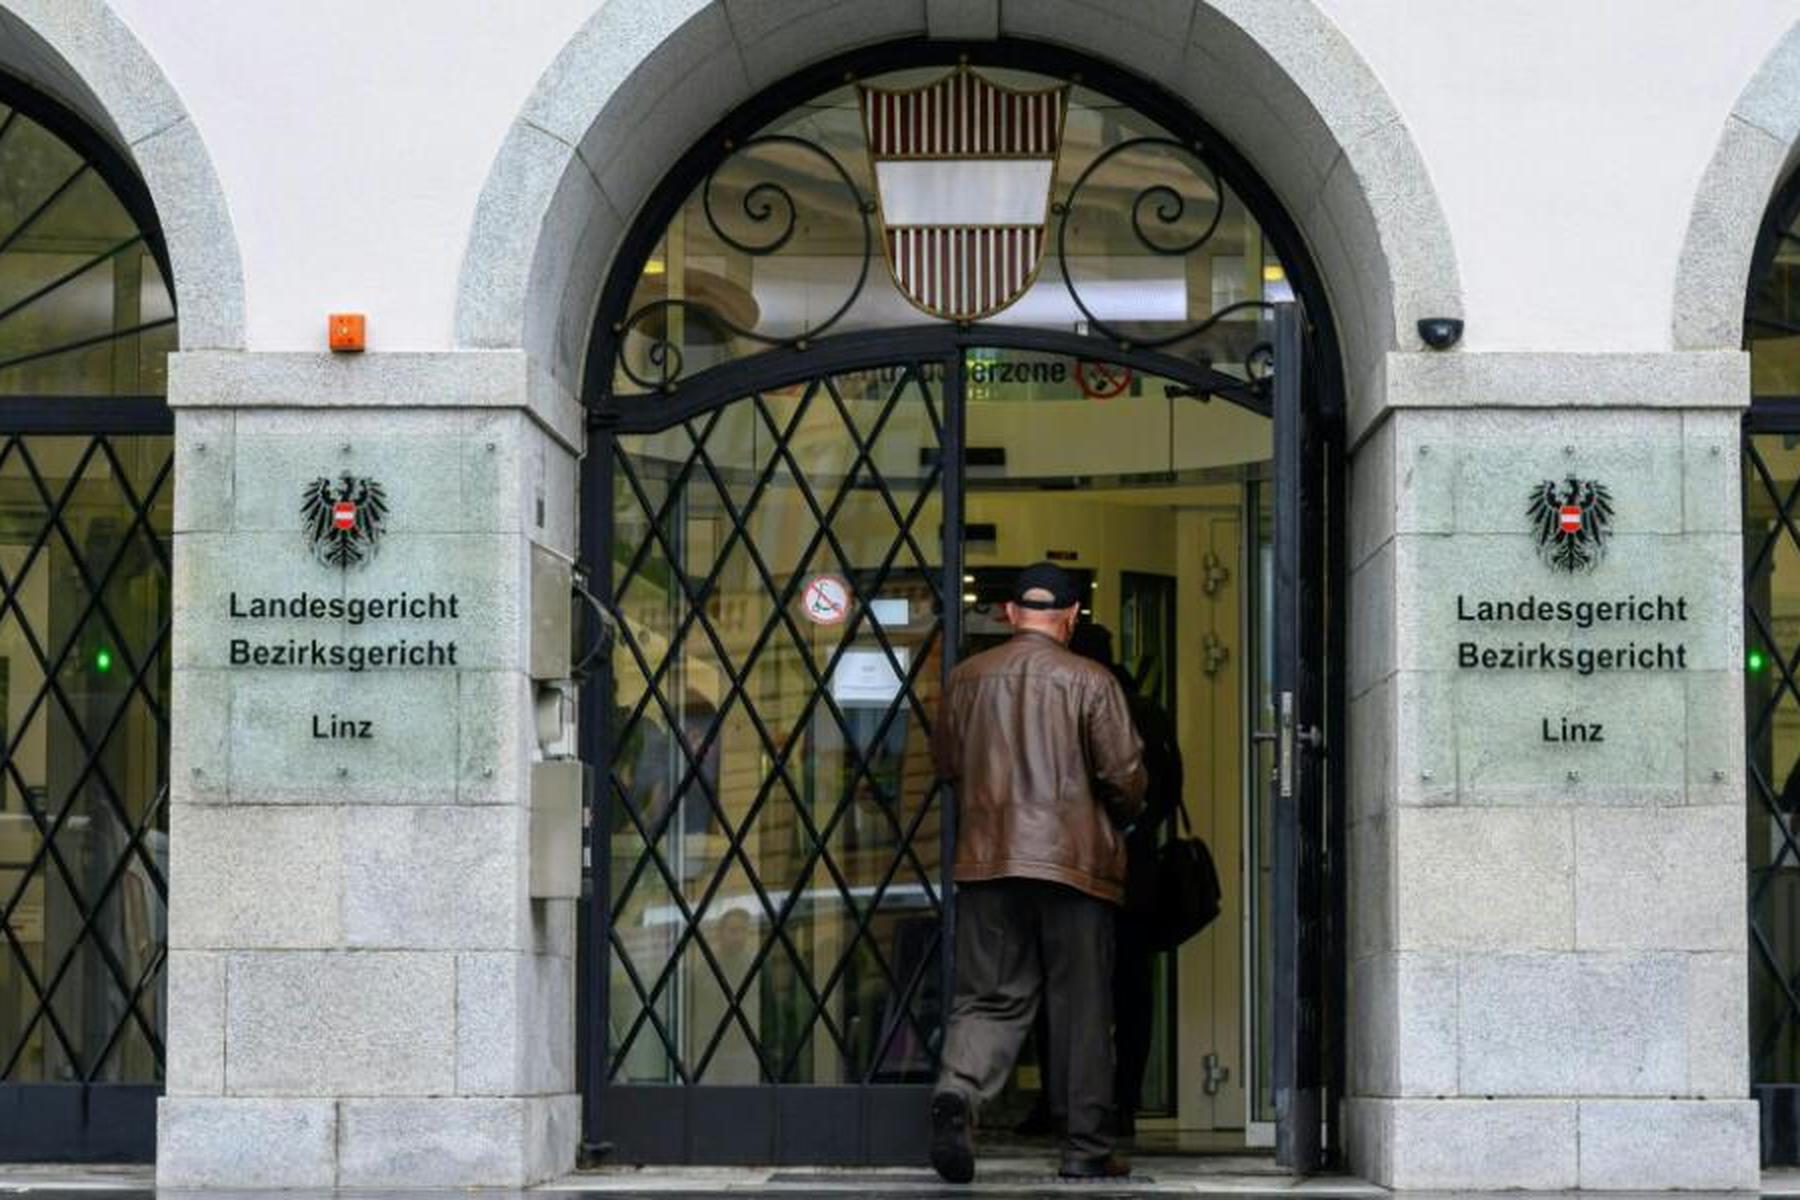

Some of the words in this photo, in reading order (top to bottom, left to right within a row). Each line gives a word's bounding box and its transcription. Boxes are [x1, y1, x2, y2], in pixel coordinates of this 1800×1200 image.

[229, 591, 459, 624] Landesgericht
[1457, 595, 1688, 628] Landesgericht
[229, 639, 457, 672] Bezirksgericht
[1458, 641, 1686, 675] Bezirksgericht
[312, 714, 373, 739] Linz
[1542, 717, 1604, 743] Linz
